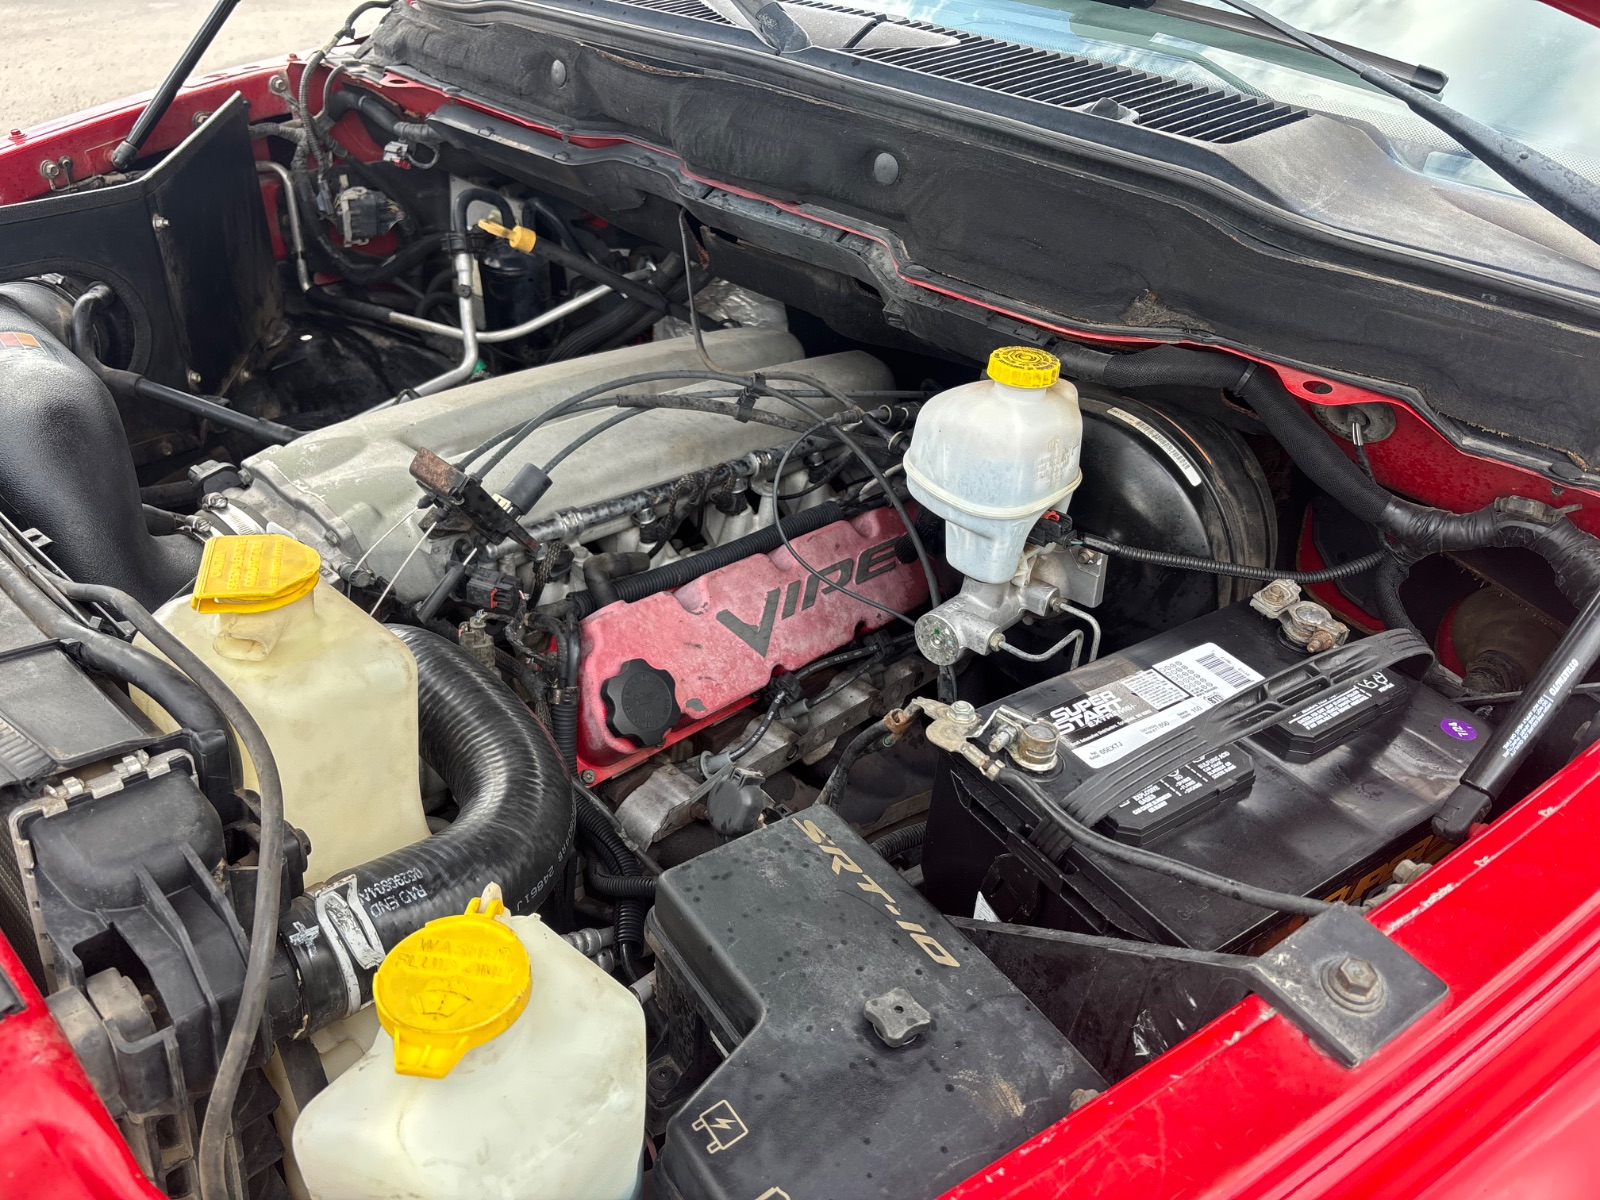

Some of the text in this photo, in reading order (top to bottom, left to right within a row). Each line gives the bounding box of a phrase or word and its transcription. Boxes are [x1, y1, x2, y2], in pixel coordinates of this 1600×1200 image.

[715, 538, 901, 658] VIPE
[1050, 690, 1117, 720] SUPER
[1052, 697, 1122, 735] START
[369, 883, 427, 918] RAD END
[792, 816, 961, 968] SRT-10
[394, 952, 457, 971] FLUID
[420, 937, 512, 961] WASHER
